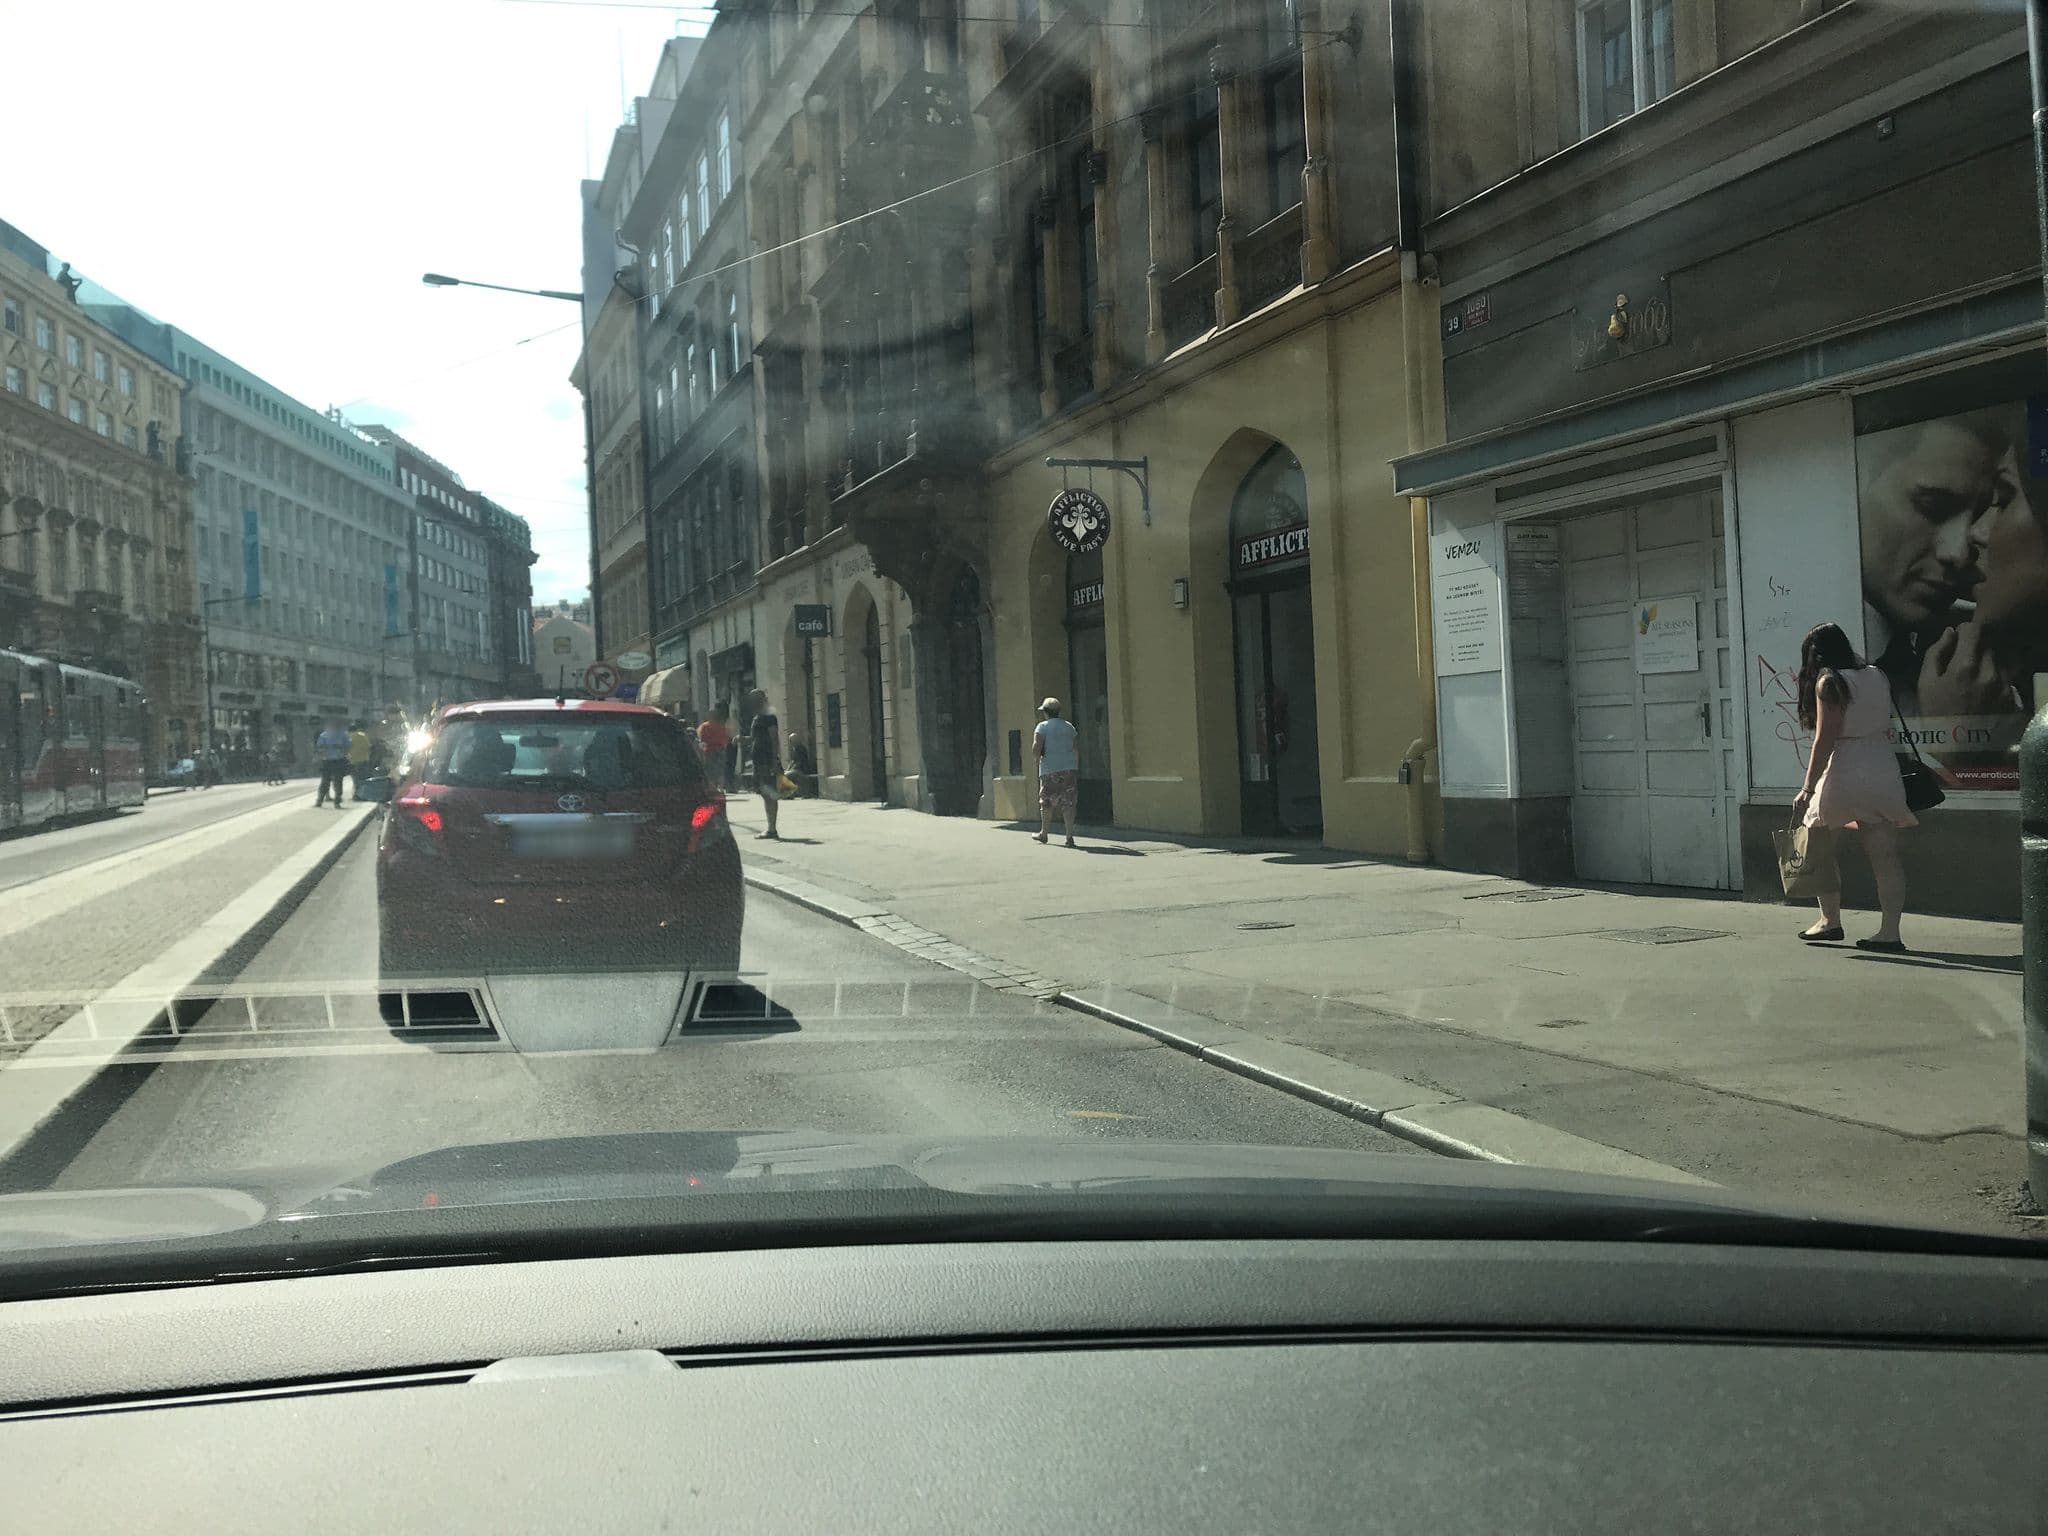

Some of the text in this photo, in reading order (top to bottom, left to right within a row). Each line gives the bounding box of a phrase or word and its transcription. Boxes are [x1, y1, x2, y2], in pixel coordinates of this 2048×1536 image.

[1447, 316, 1459, 331] 39
[1054, 493, 1106, 520] AFFLICTION
[1056, 530, 1103, 552] LIVE FAST
[1952, 725, 1992, 744] CITY
[1955, 769, 2021, 780] www.eroticcit
